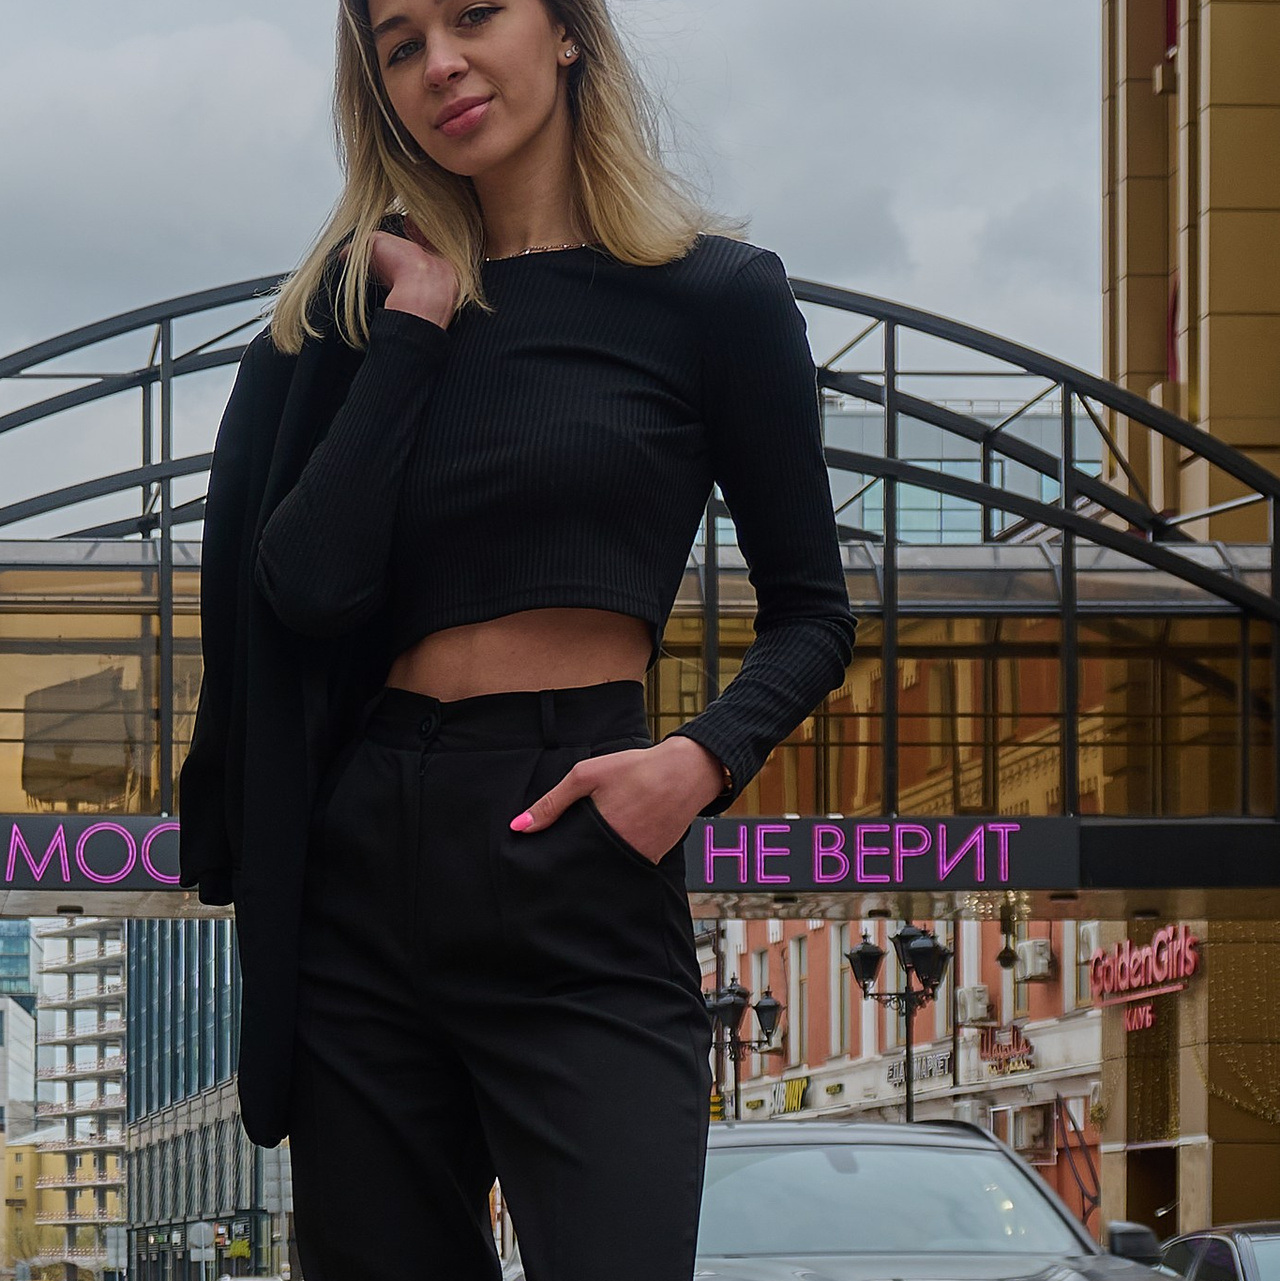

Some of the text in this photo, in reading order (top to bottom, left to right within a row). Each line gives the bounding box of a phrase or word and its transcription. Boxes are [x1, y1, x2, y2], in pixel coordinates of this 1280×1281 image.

[5, 822, 1020, 884] МОС НЕ ВЕРИТ
[770, 1076, 808, 1114] SUBWAY
